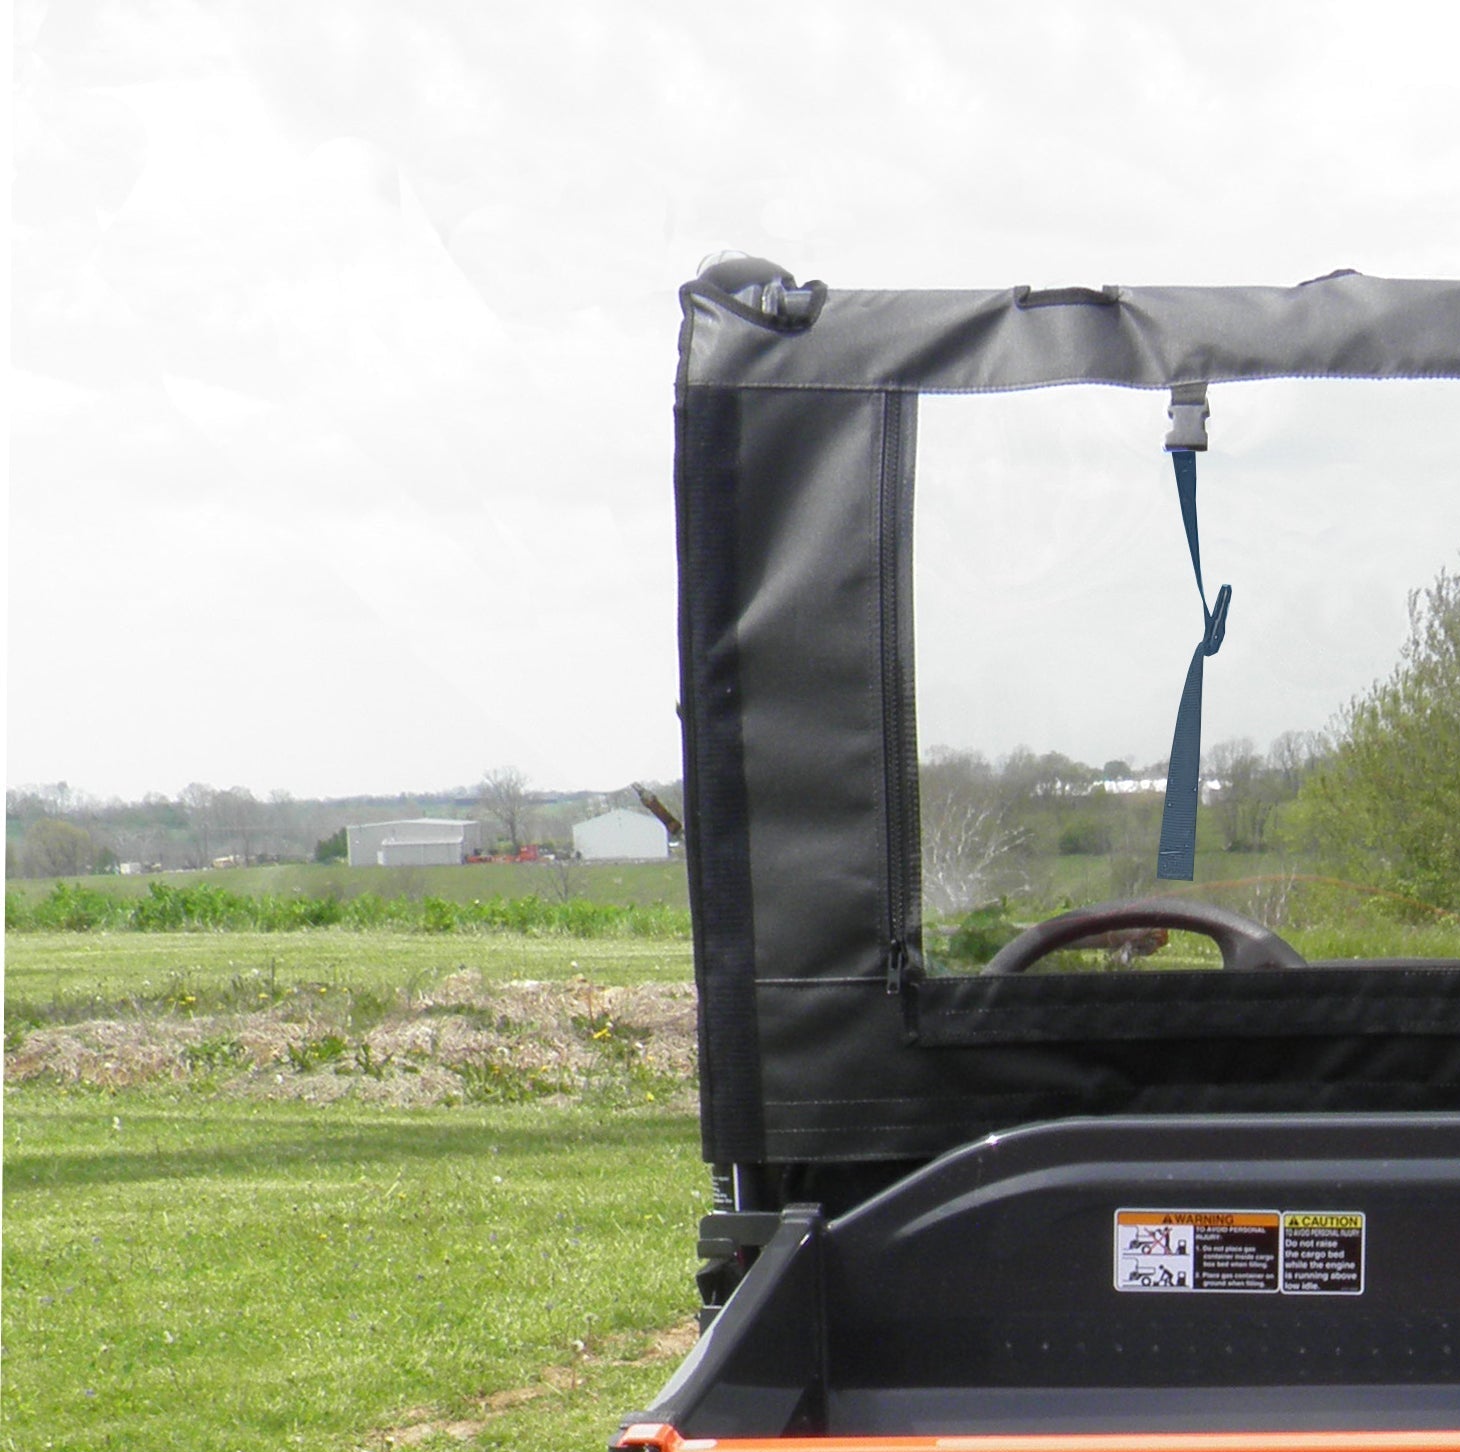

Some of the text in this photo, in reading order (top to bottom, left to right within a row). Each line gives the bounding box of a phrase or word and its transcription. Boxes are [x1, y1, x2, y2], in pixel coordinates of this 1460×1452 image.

[1176, 1214, 1234, 1224] WARNING
[1302, 1217, 1358, 1226] CAUTION
[1285, 1240, 1338, 1248] Do not raise
[1285, 1250, 1345, 1260] the cargo bed
[1285, 1261, 1356, 1271] while the engine
[1294, 1272, 1329, 1281] running
